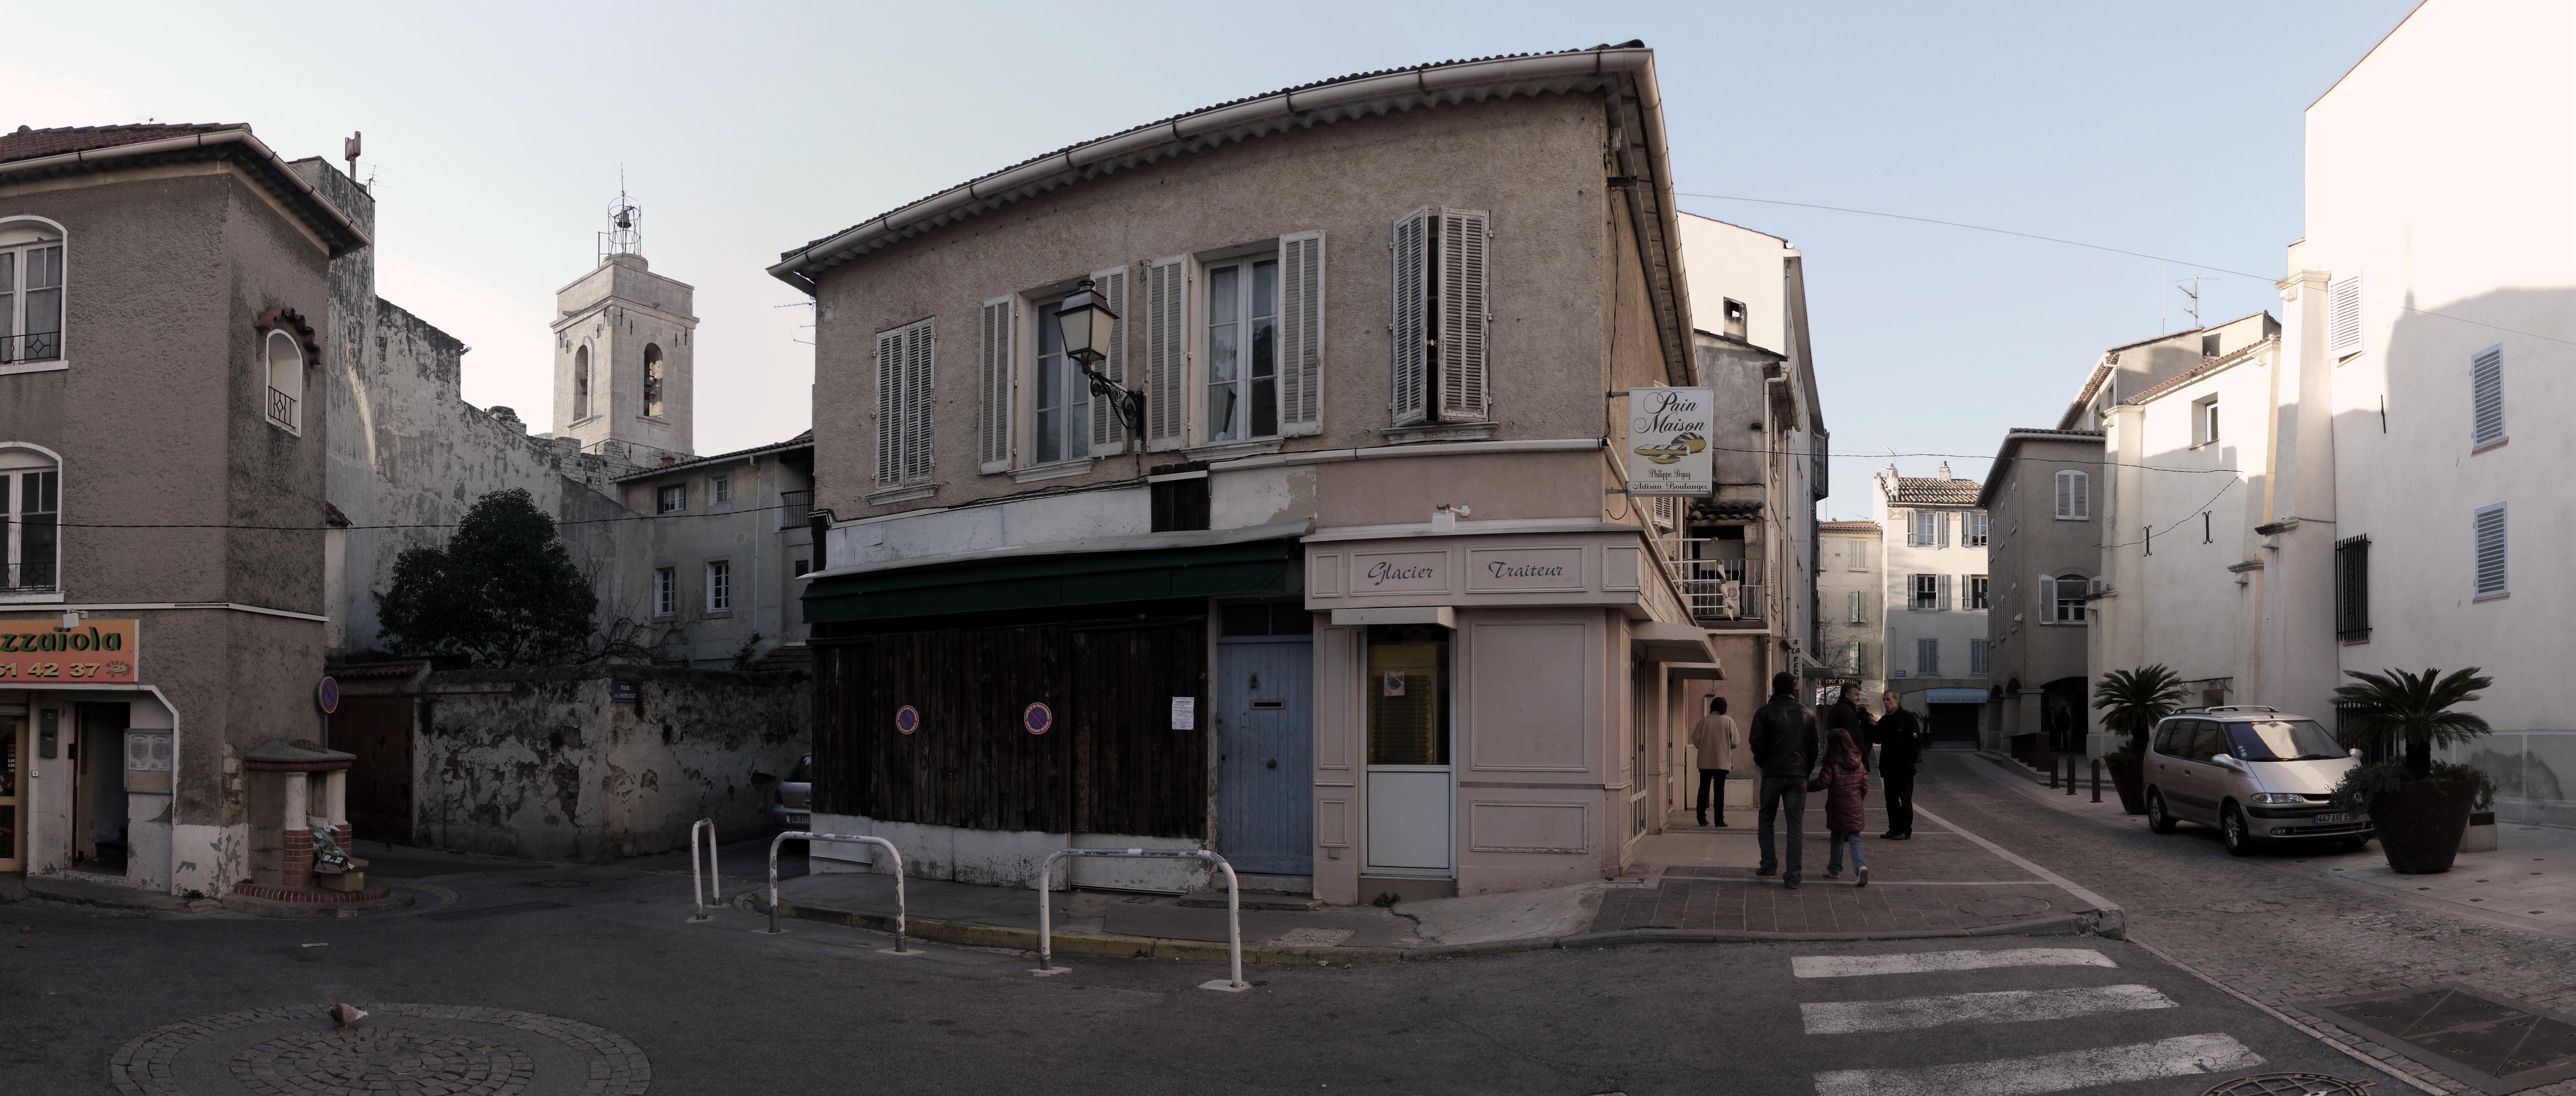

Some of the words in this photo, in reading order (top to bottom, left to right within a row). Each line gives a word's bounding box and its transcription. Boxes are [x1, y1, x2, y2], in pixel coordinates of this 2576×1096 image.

[1643, 390, 1699, 414] Pain
[1633, 412, 1707, 434] Maison
[1649, 468, 1672, 480] Philippe
[1666, 482, 1708, 491] Boulanger
[1367, 561, 1433, 586] Glacier
[1488, 561, 1563, 579] Traiteur
[28, 662, 59, 677] 42
[70, 662, 100, 678] 37
[1265, 665, 1272, 677] 2
[1041, 705, 1050, 720] STATIONNER
[1026, 721, 1041, 733] EMPLACEMENT
[2332, 813, 2343, 822] AVE
